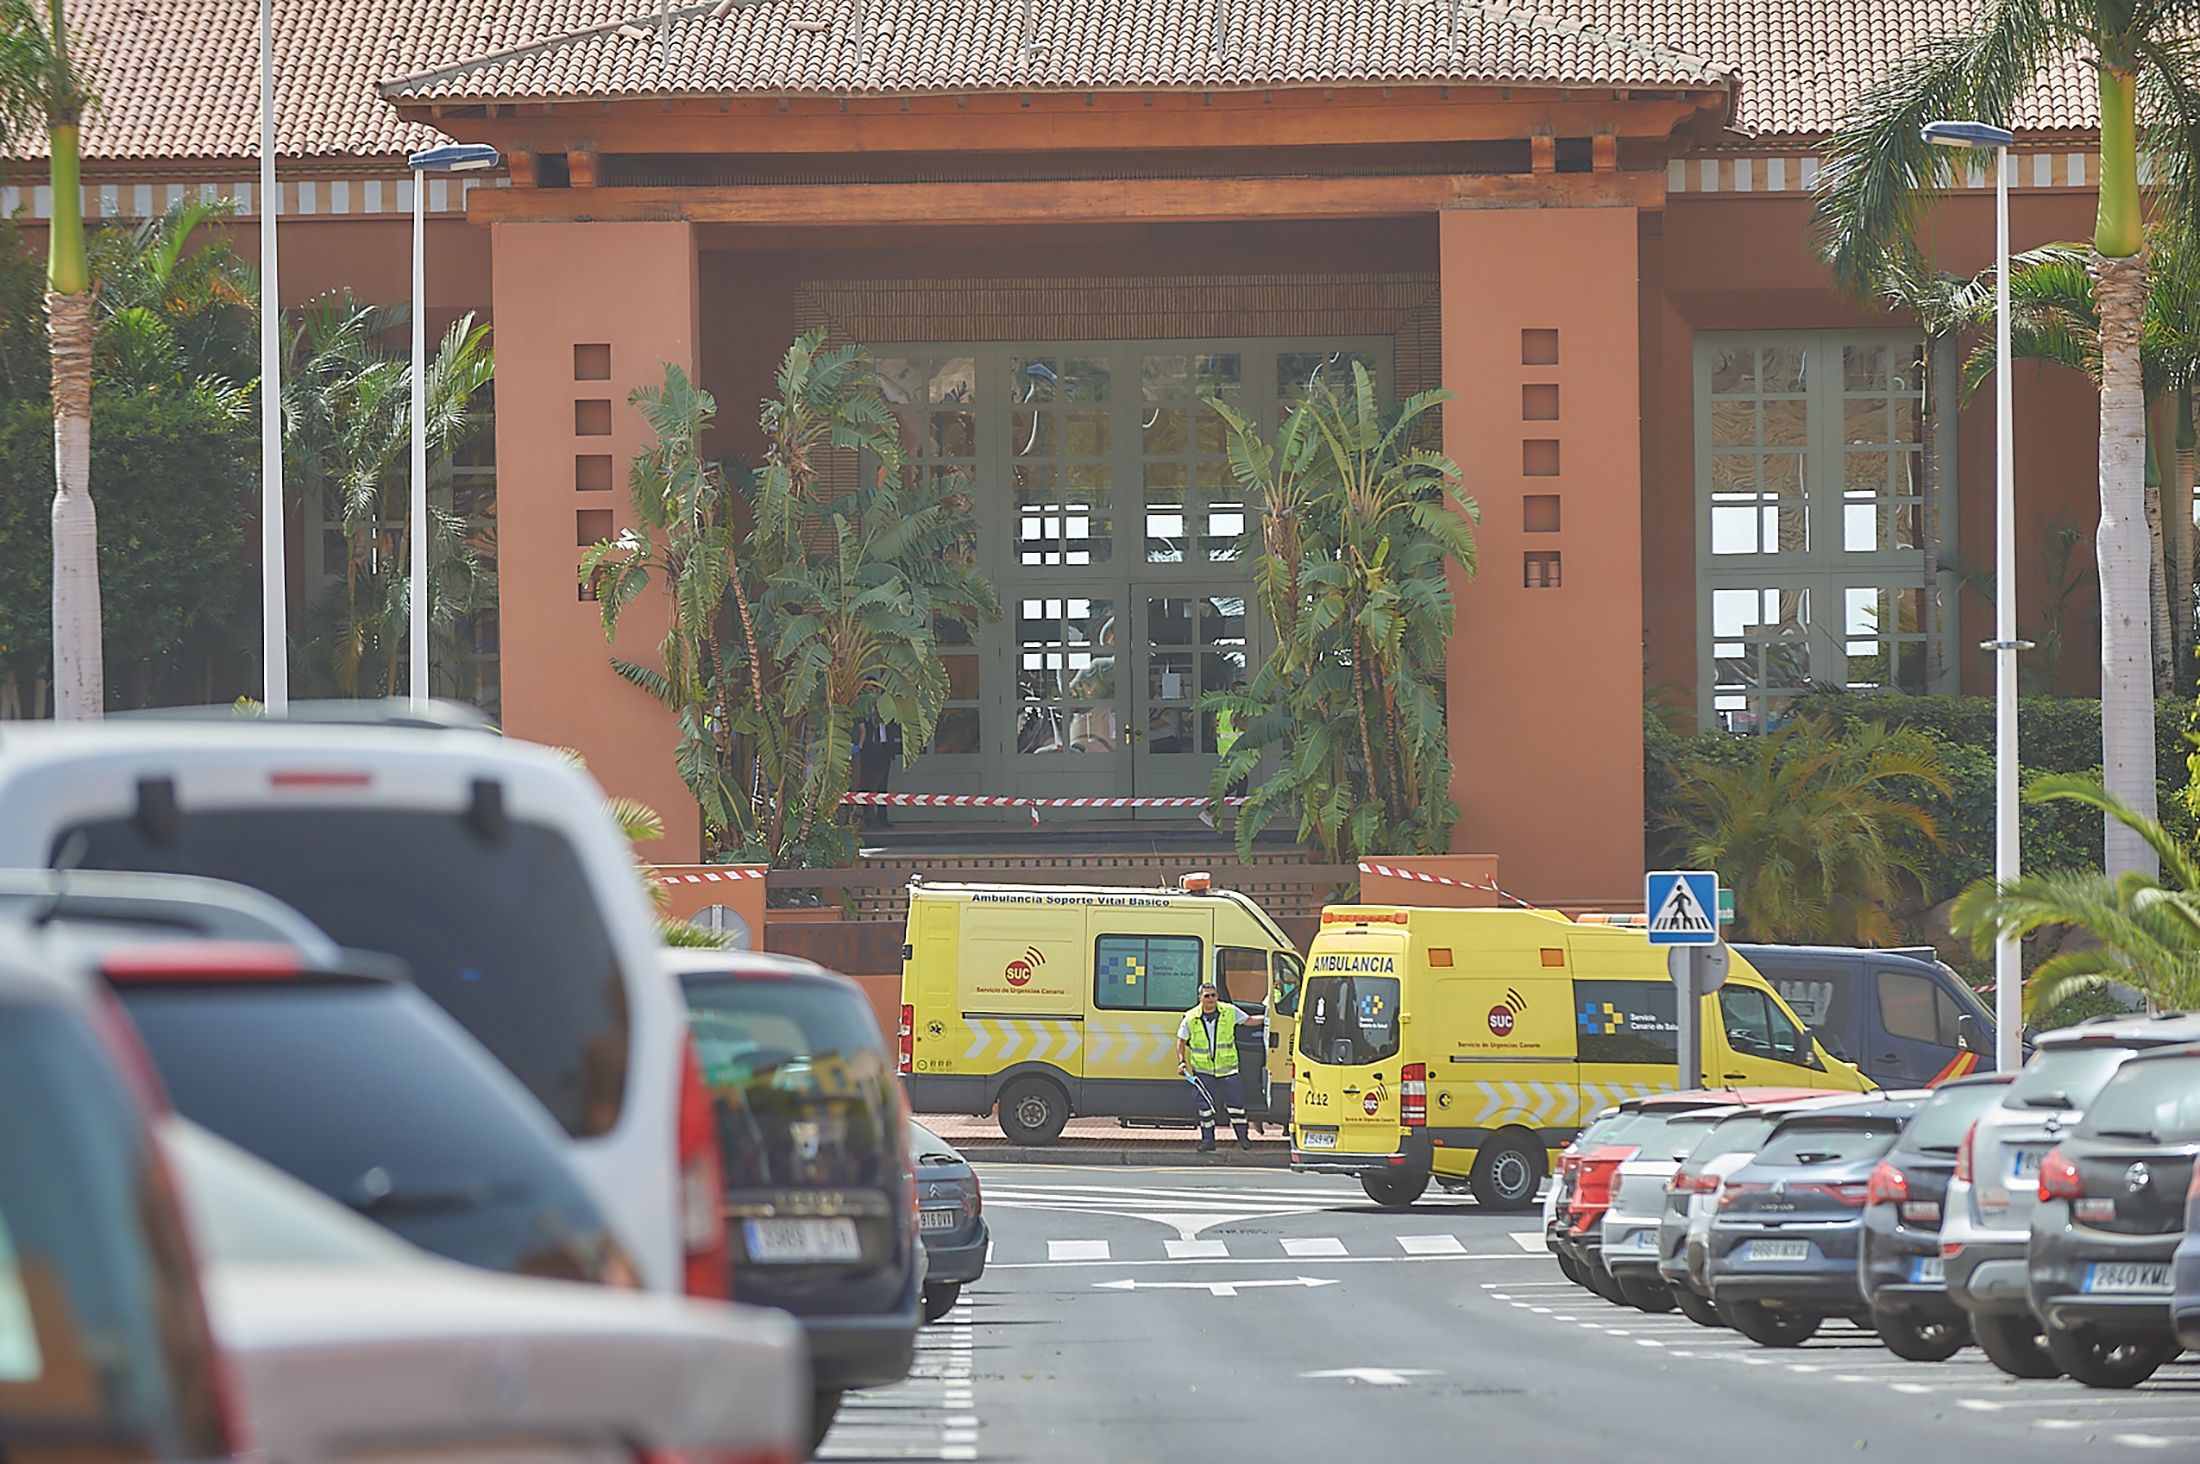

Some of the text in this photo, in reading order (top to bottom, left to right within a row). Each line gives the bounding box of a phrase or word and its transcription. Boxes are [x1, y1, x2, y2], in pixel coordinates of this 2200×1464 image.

[972, 893, 1043, 904] Ambulancia
[1046, 895, 1094, 906] Soporte
[1097, 896, 1126, 905] Vital
[1313, 956, 1394, 973] AMBULANCIA
[1006, 967, 1030, 980] SUC
[976, 986, 1001, 994] Servicio
[1490, 1015, 1512, 1028] SUC
[1630, 1013, 1656, 1021] Servicio
[1631, 1022, 1680, 1031] Canario de Salu
[1363, 1100, 1378, 1110] SUC
[2098, 1264, 2138, 1286] 2840
